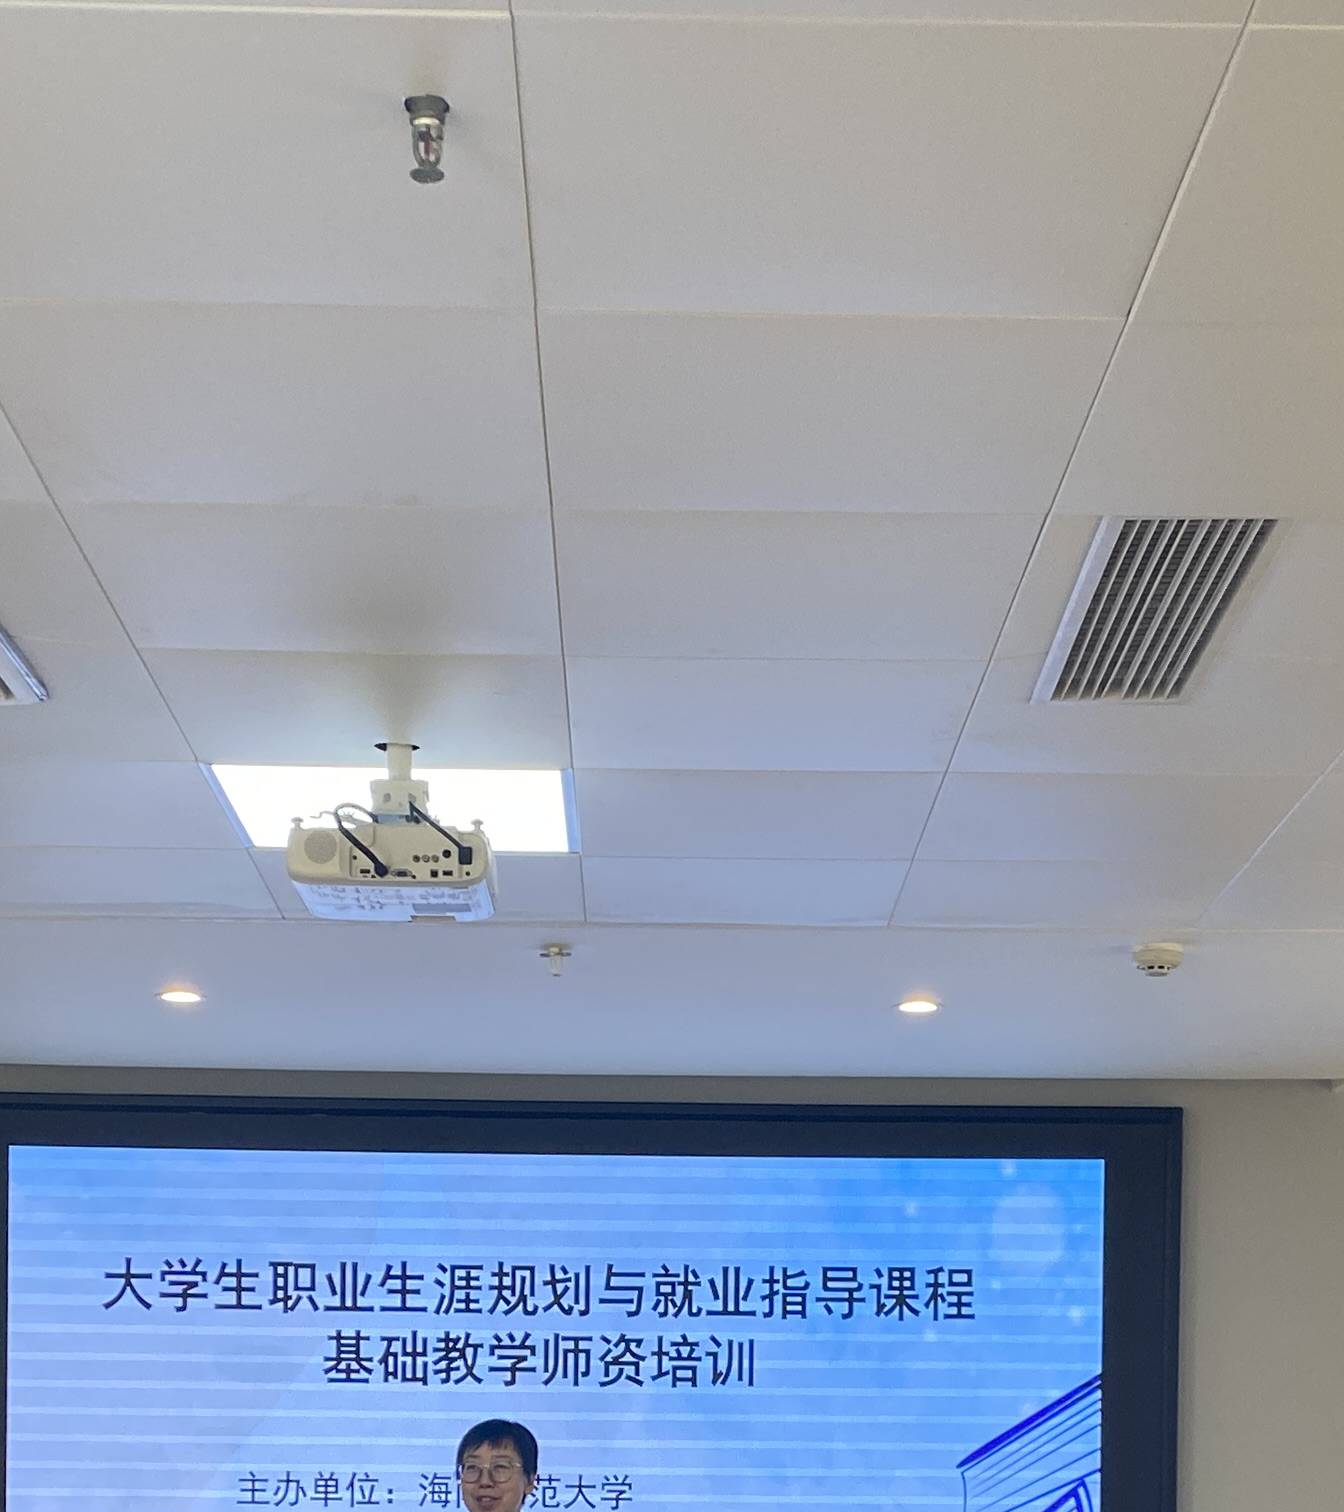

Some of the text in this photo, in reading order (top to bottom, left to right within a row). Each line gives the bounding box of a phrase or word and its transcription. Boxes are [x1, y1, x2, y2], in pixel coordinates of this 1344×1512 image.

[102, 1256, 976, 1321] 大学生职业生涯规划与就业指导课程
[322, 1329, 756, 1388] 基础教学师资培训
